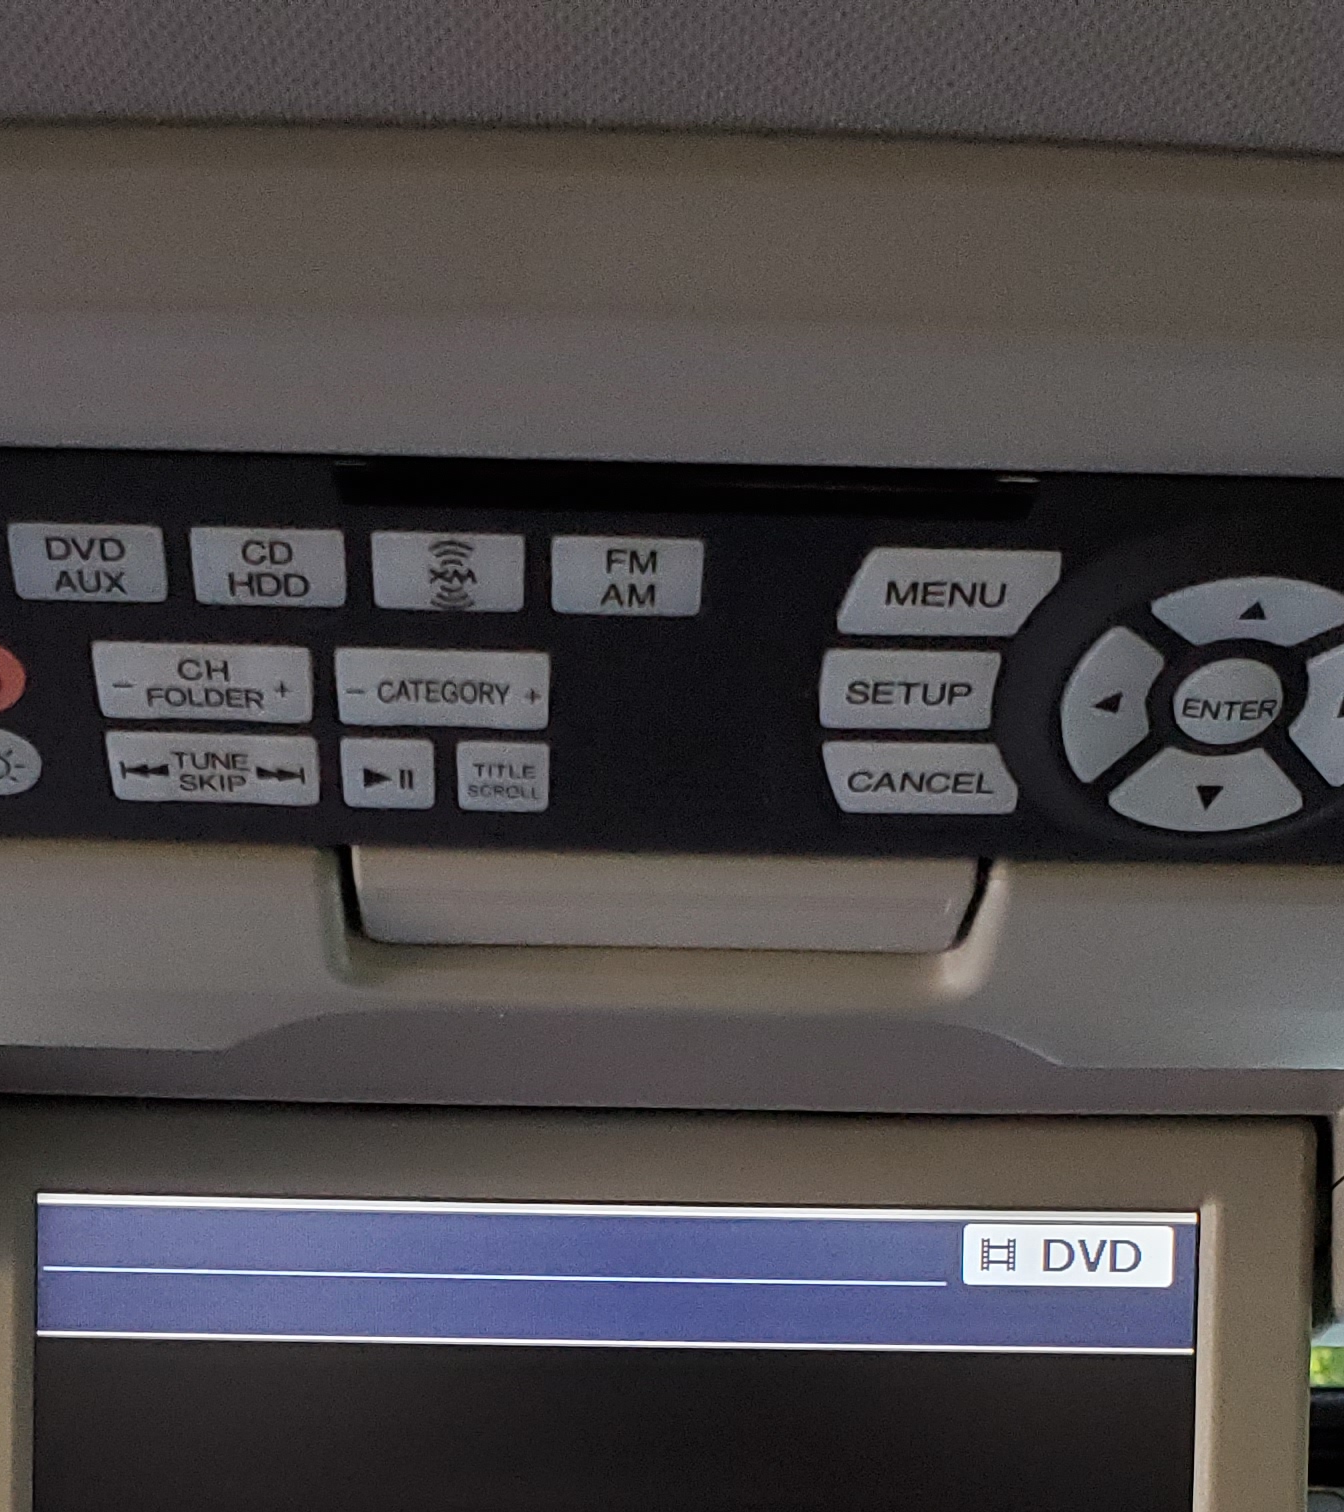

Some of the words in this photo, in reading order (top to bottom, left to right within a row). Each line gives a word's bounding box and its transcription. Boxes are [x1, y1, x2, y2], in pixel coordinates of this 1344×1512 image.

[45, 535, 127, 563] DVD
[241, 539, 294, 566] CD
[606, 549, 657, 575] FM
[55, 569, 128, 596] AUX
[227, 571, 311, 598] HDD
[600, 583, 657, 609] AM
[883, 580, 1008, 611] MENU
[176, 658, 230, 682] CH
[145, 686, 265, 711] FOLDER
[375, 680, 512, 707] CATEGORY
[844, 678, 975, 709] SETUP
[1179, 697, 1280, 724] ENTER
[170, 750, 251, 773] TUNE
[471, 761, 538, 781] TITLE
[179, 772, 249, 794] SKIP
[466, 782, 542, 801] SCROLL
[845, 769, 997, 797] CANCEL
[1040, 1236, 1144, 1277] DVD
